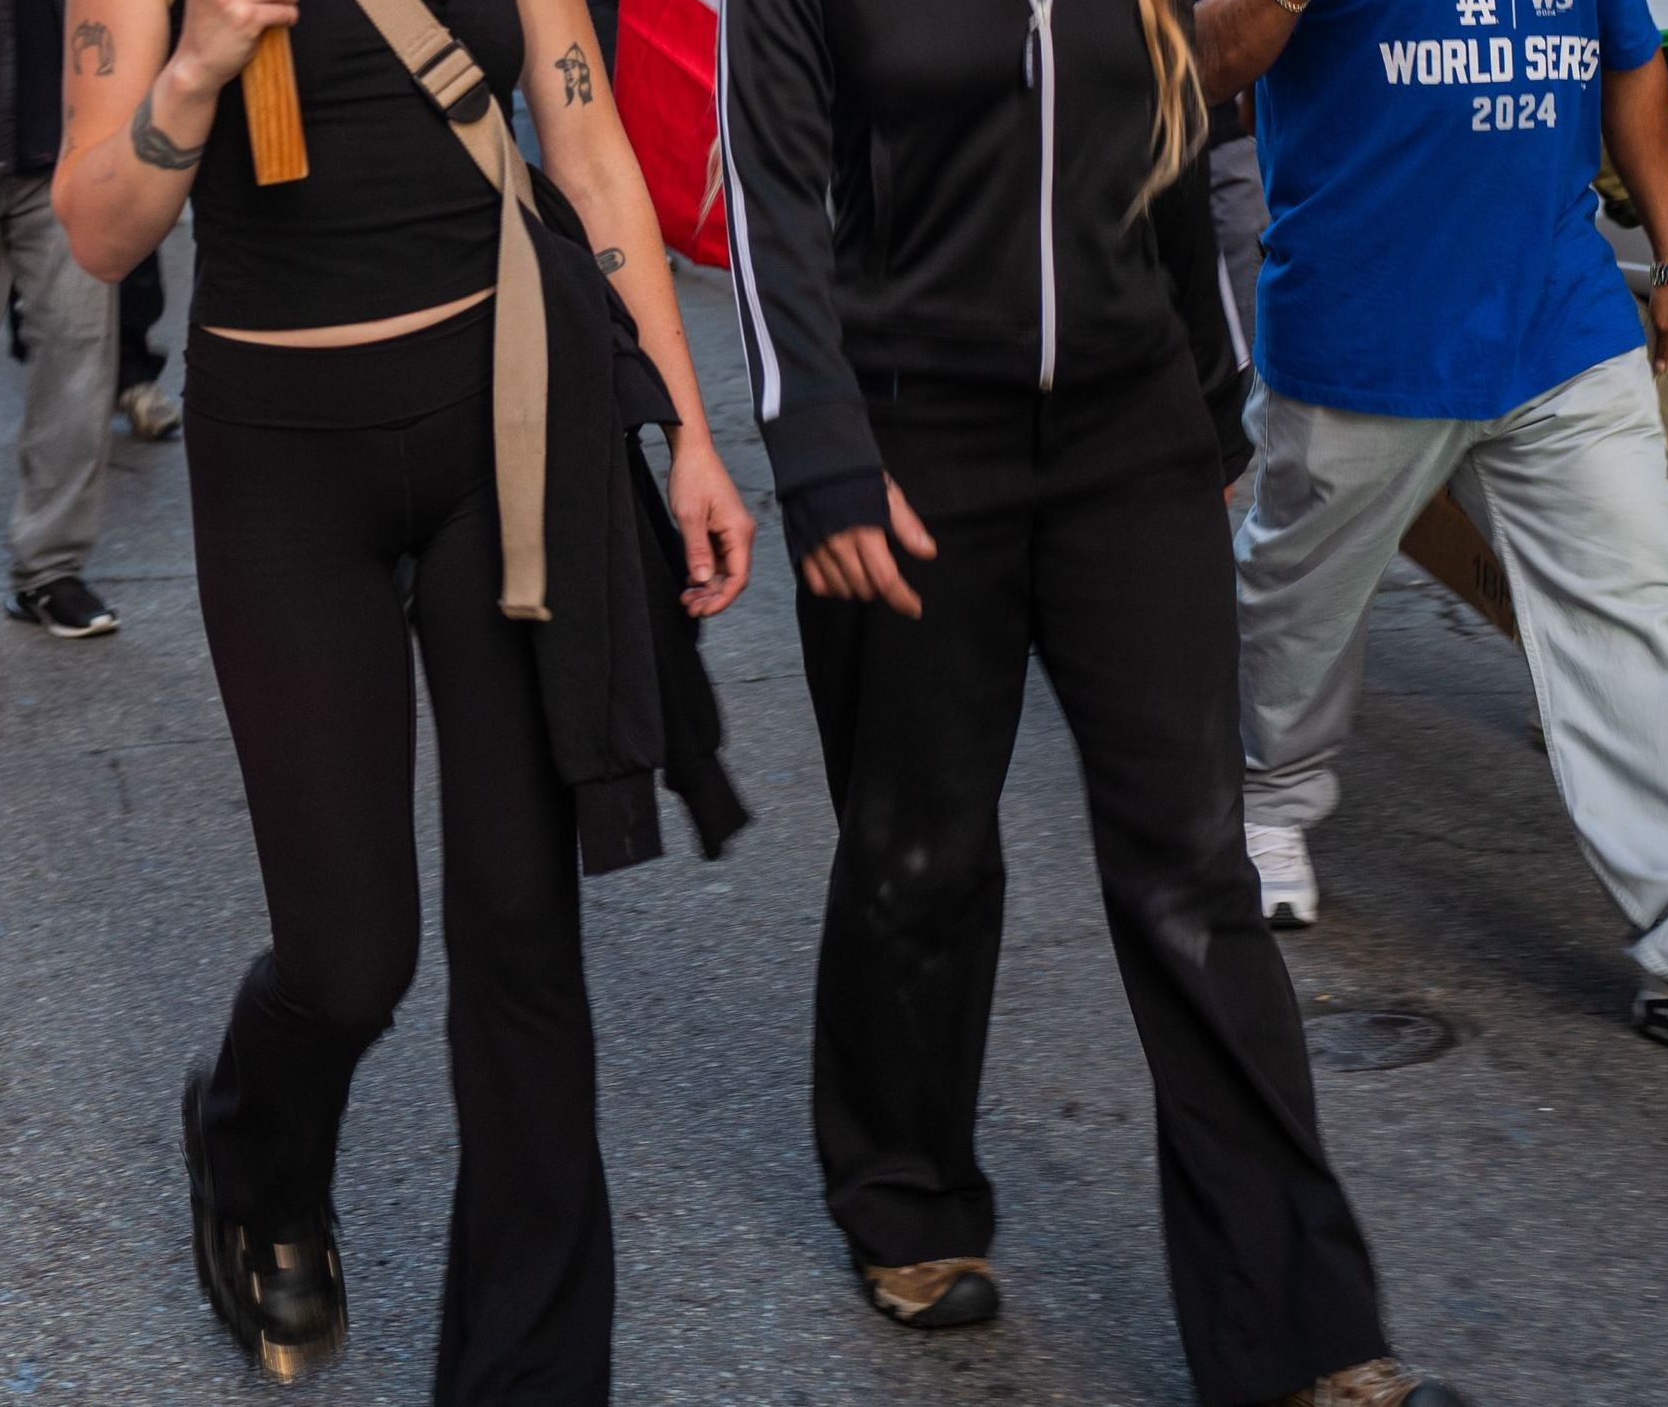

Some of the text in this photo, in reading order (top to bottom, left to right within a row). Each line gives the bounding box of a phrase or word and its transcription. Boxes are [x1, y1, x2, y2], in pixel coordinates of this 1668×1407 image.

[1379, 35, 1600, 85] WORLD SERS
[1471, 92, 1557, 132] 2024
